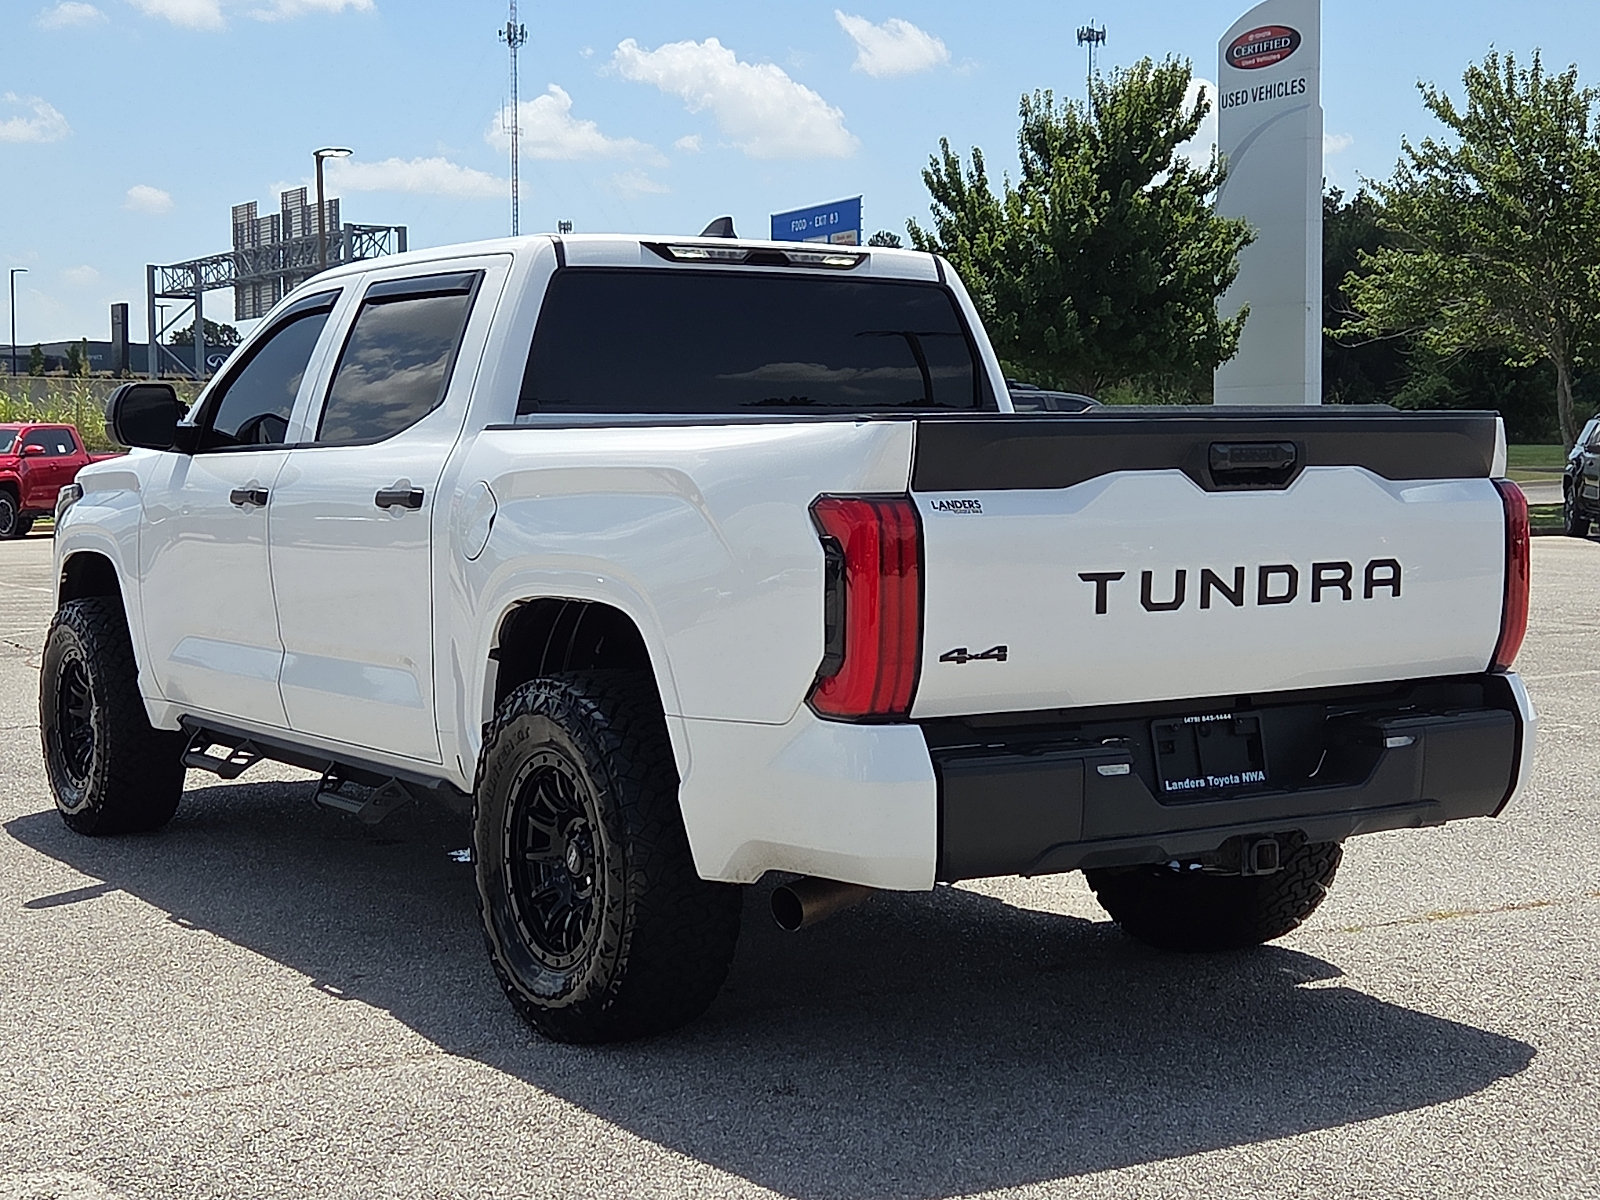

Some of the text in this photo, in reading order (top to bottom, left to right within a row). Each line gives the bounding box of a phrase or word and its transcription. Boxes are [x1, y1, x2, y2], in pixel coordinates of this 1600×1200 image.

[1233, 37, 1291, 58] CERTIFIED
[1221, 78, 1306, 109] USED VEHICLES
[791, 218, 808, 232] FOOD
[814, 214, 827, 228] EXIT
[930, 499, 982, 511] LANDERS
[1078, 558, 1401, 615] TUNDRA
[939, 645, 1008, 665] 4x4
[1165, 770, 1266, 791] Landers Toyota NWA
